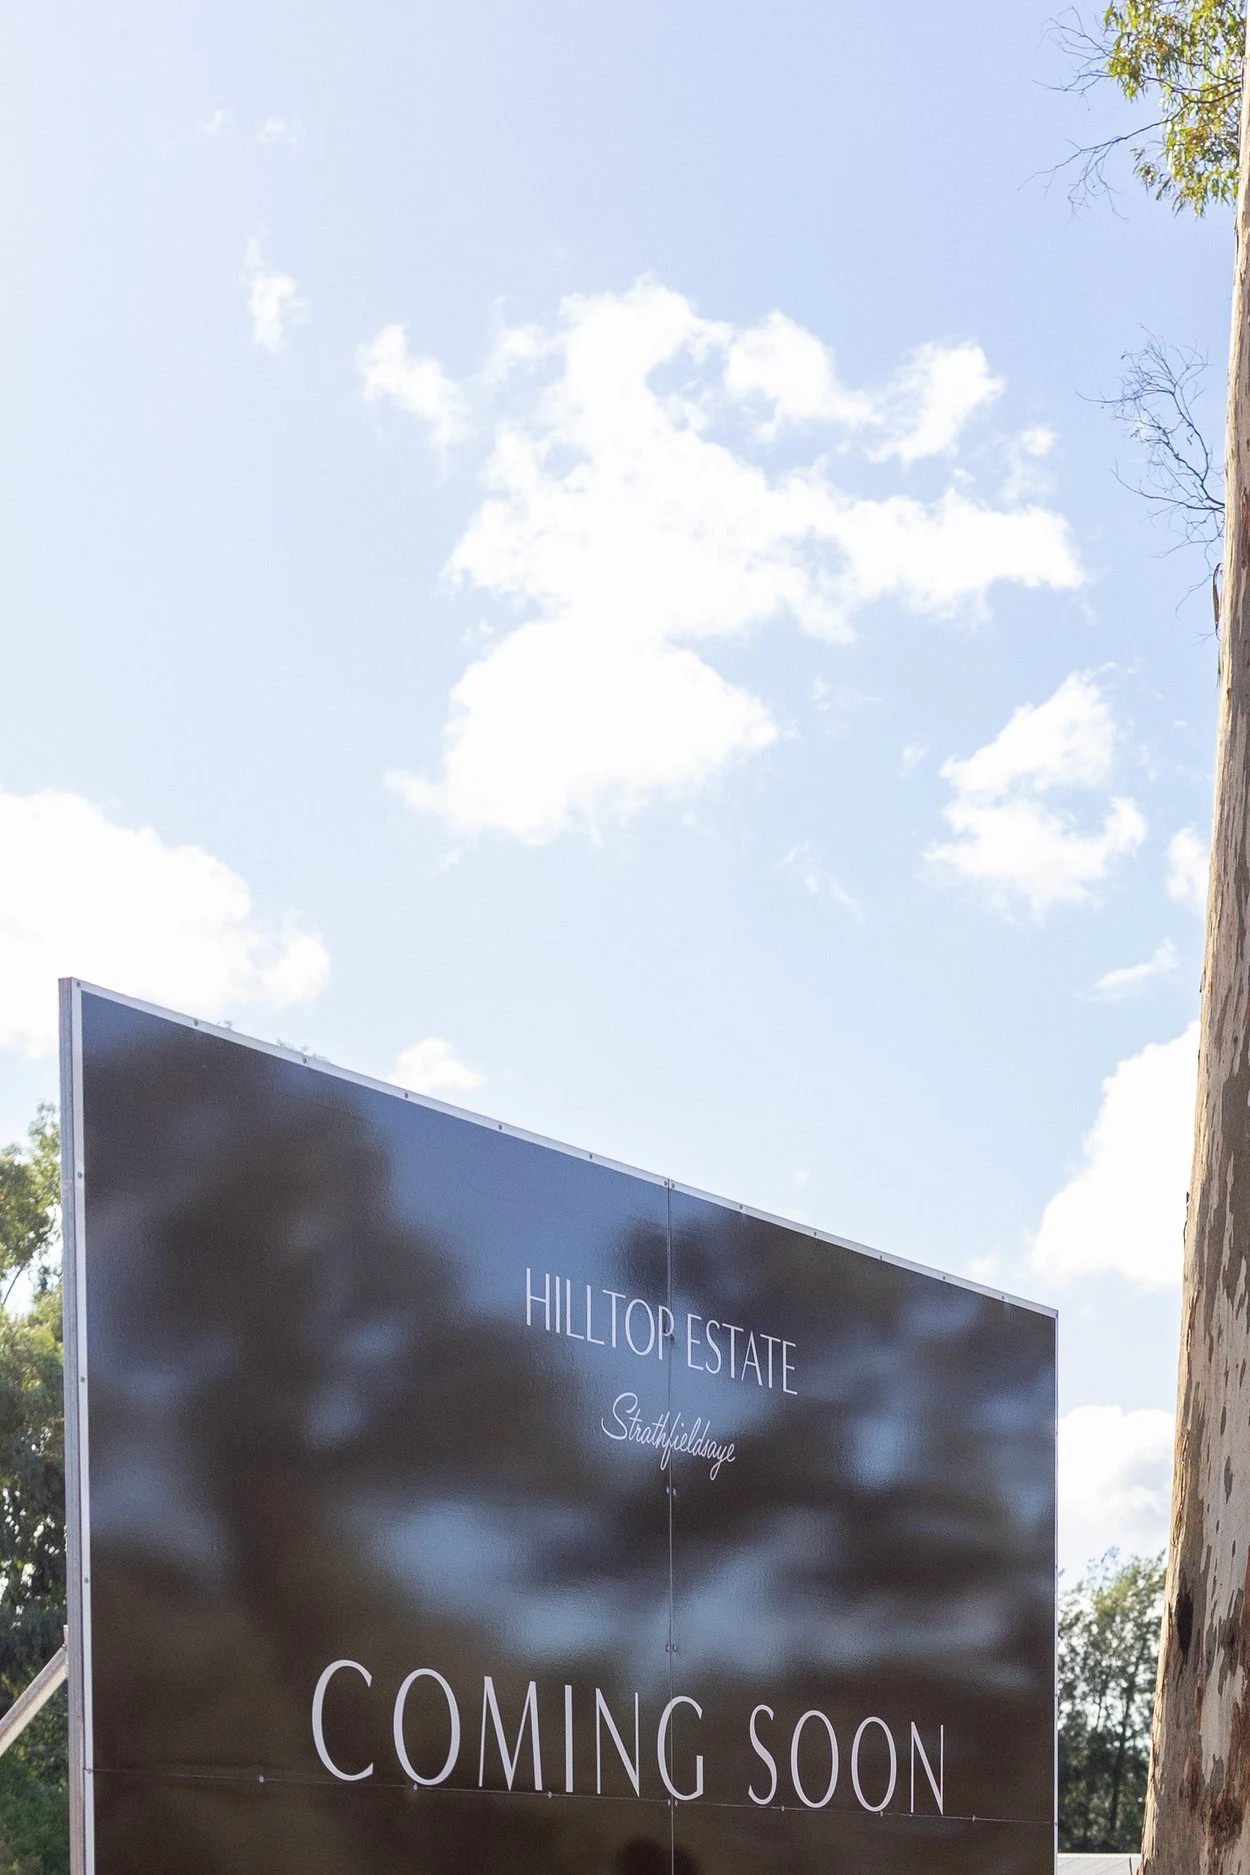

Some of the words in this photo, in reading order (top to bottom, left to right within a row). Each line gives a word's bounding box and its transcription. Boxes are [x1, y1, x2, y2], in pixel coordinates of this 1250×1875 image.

[526, 1267, 674, 1360] HILLTOP
[687, 1313, 798, 1395] ESTATE
[601, 1392, 736, 1480] Strathfieldsaye
[311, 1659, 704, 1801] COMING
[748, 1704, 944, 1815] SOON
